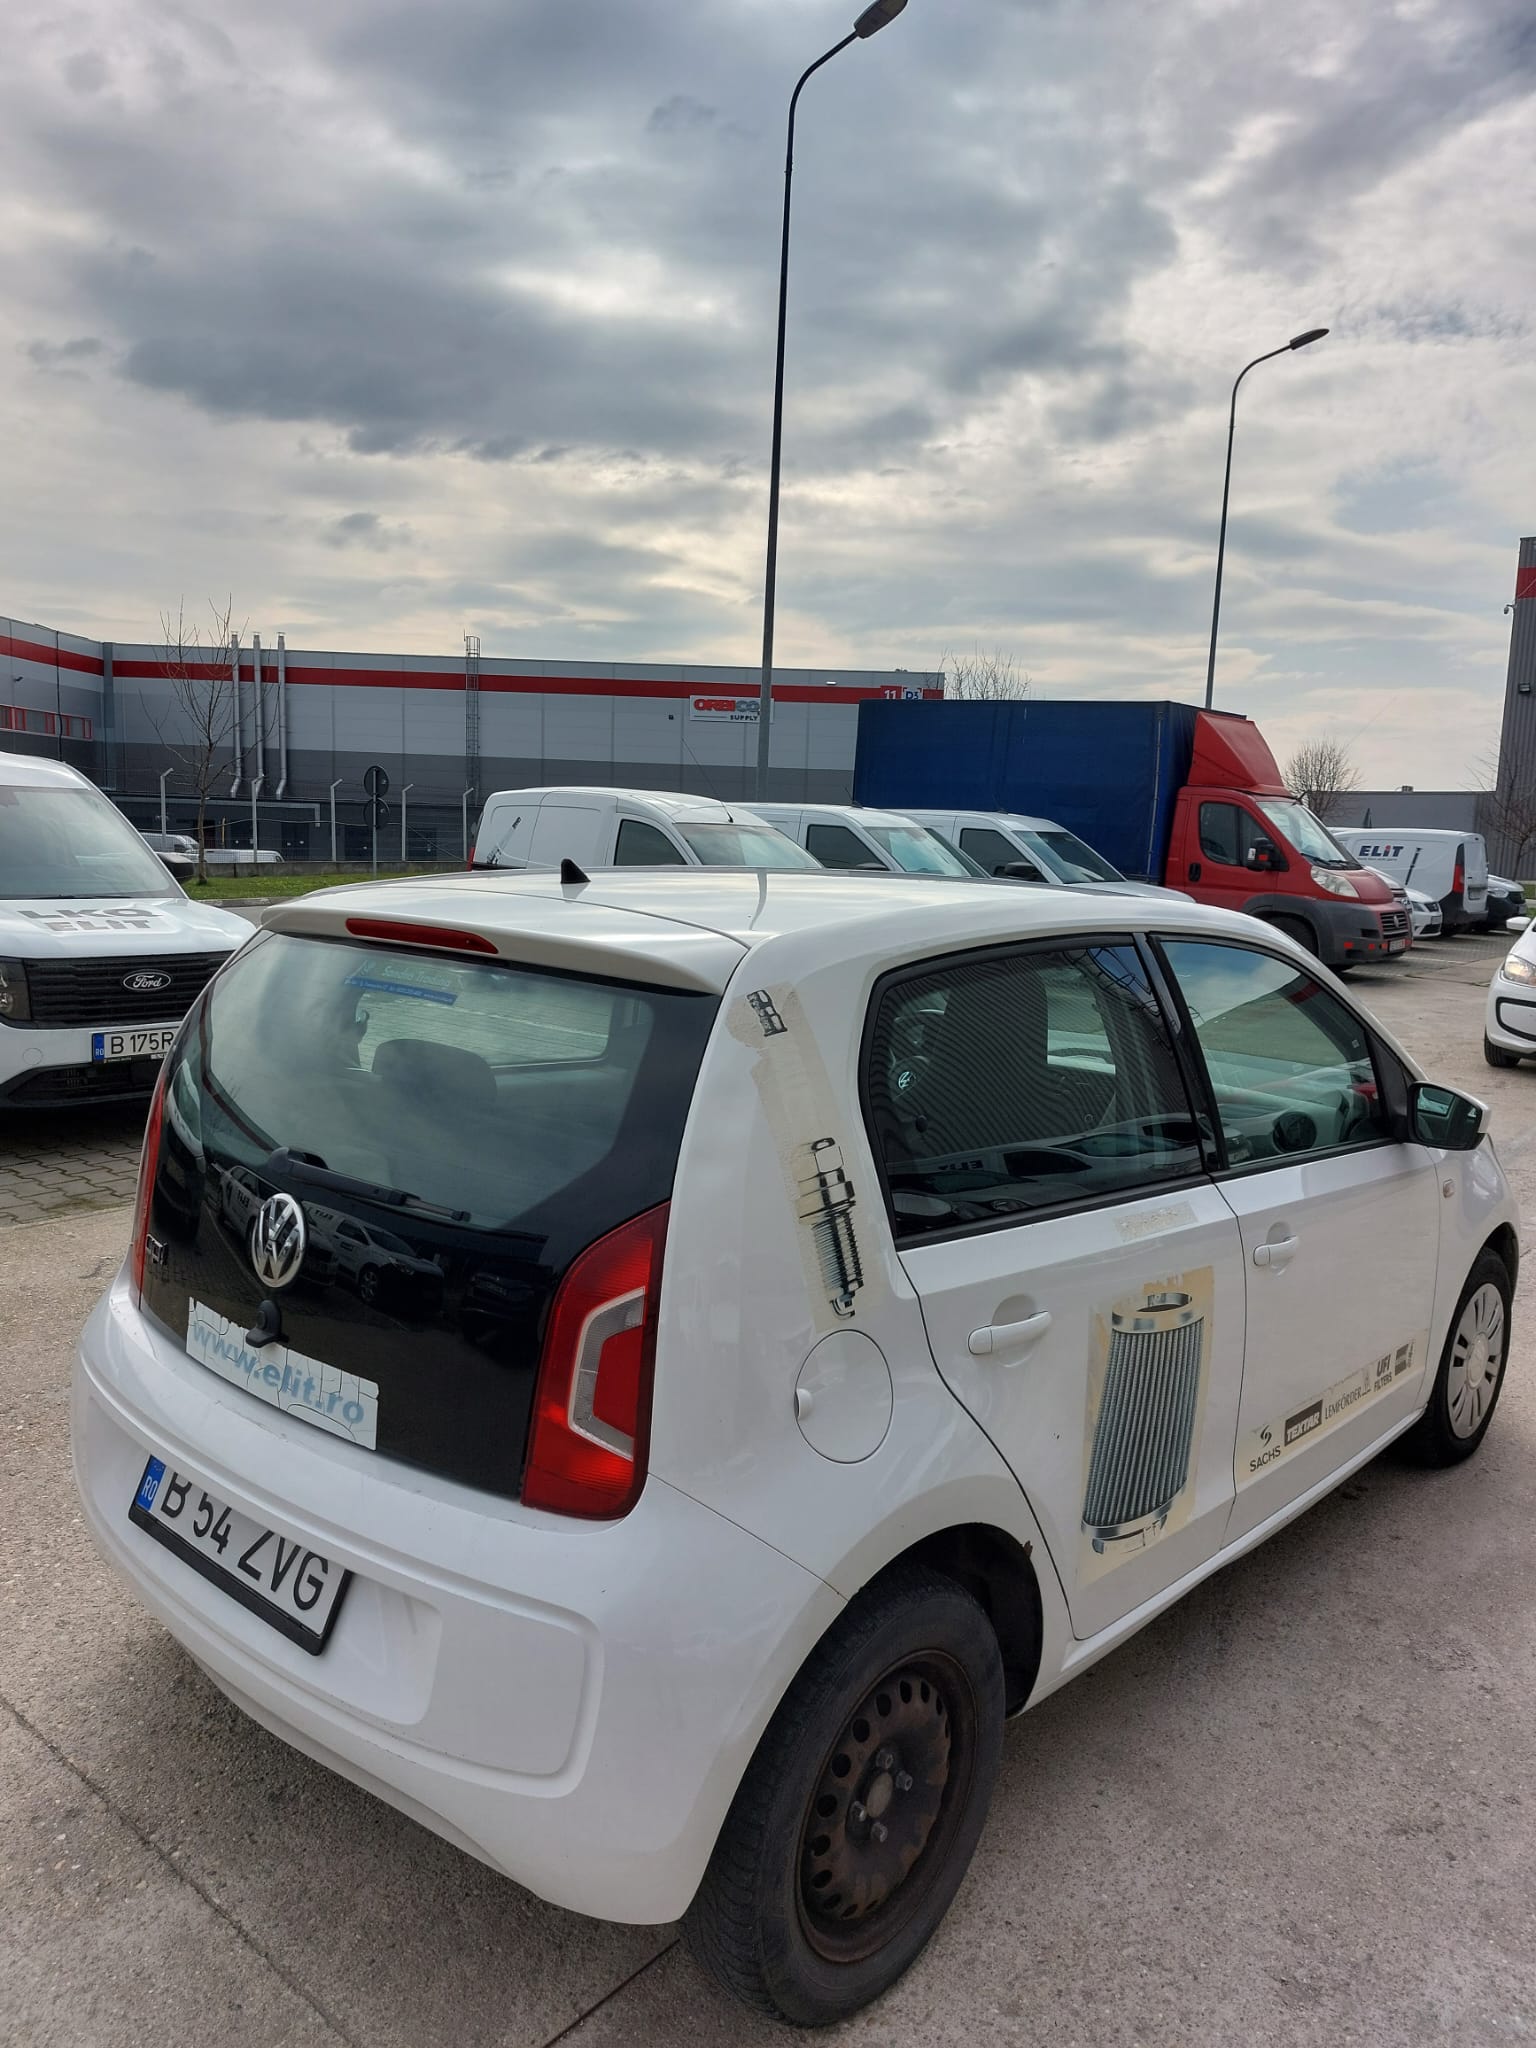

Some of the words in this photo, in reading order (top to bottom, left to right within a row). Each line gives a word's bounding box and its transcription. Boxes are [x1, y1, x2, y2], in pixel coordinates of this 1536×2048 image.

[884, 689, 897, 700] 11
[17, 908, 163, 918] LKQ
[133, 975, 162, 988] Ford
[111, 1036, 124, 1054] B
[1376, 1353, 1391, 1377] UFI
[1373, 1371, 1392, 1392] FILTERS
[1286, 1411, 1321, 1443] TEXTAR
[1249, 1445, 1282, 1473] SACHS
[141, 1475, 158, 1500] RO
[160, 1472, 193, 1519] B
[192, 1492, 232, 1555] 54
[237, 1530, 329, 1611] ZVG
